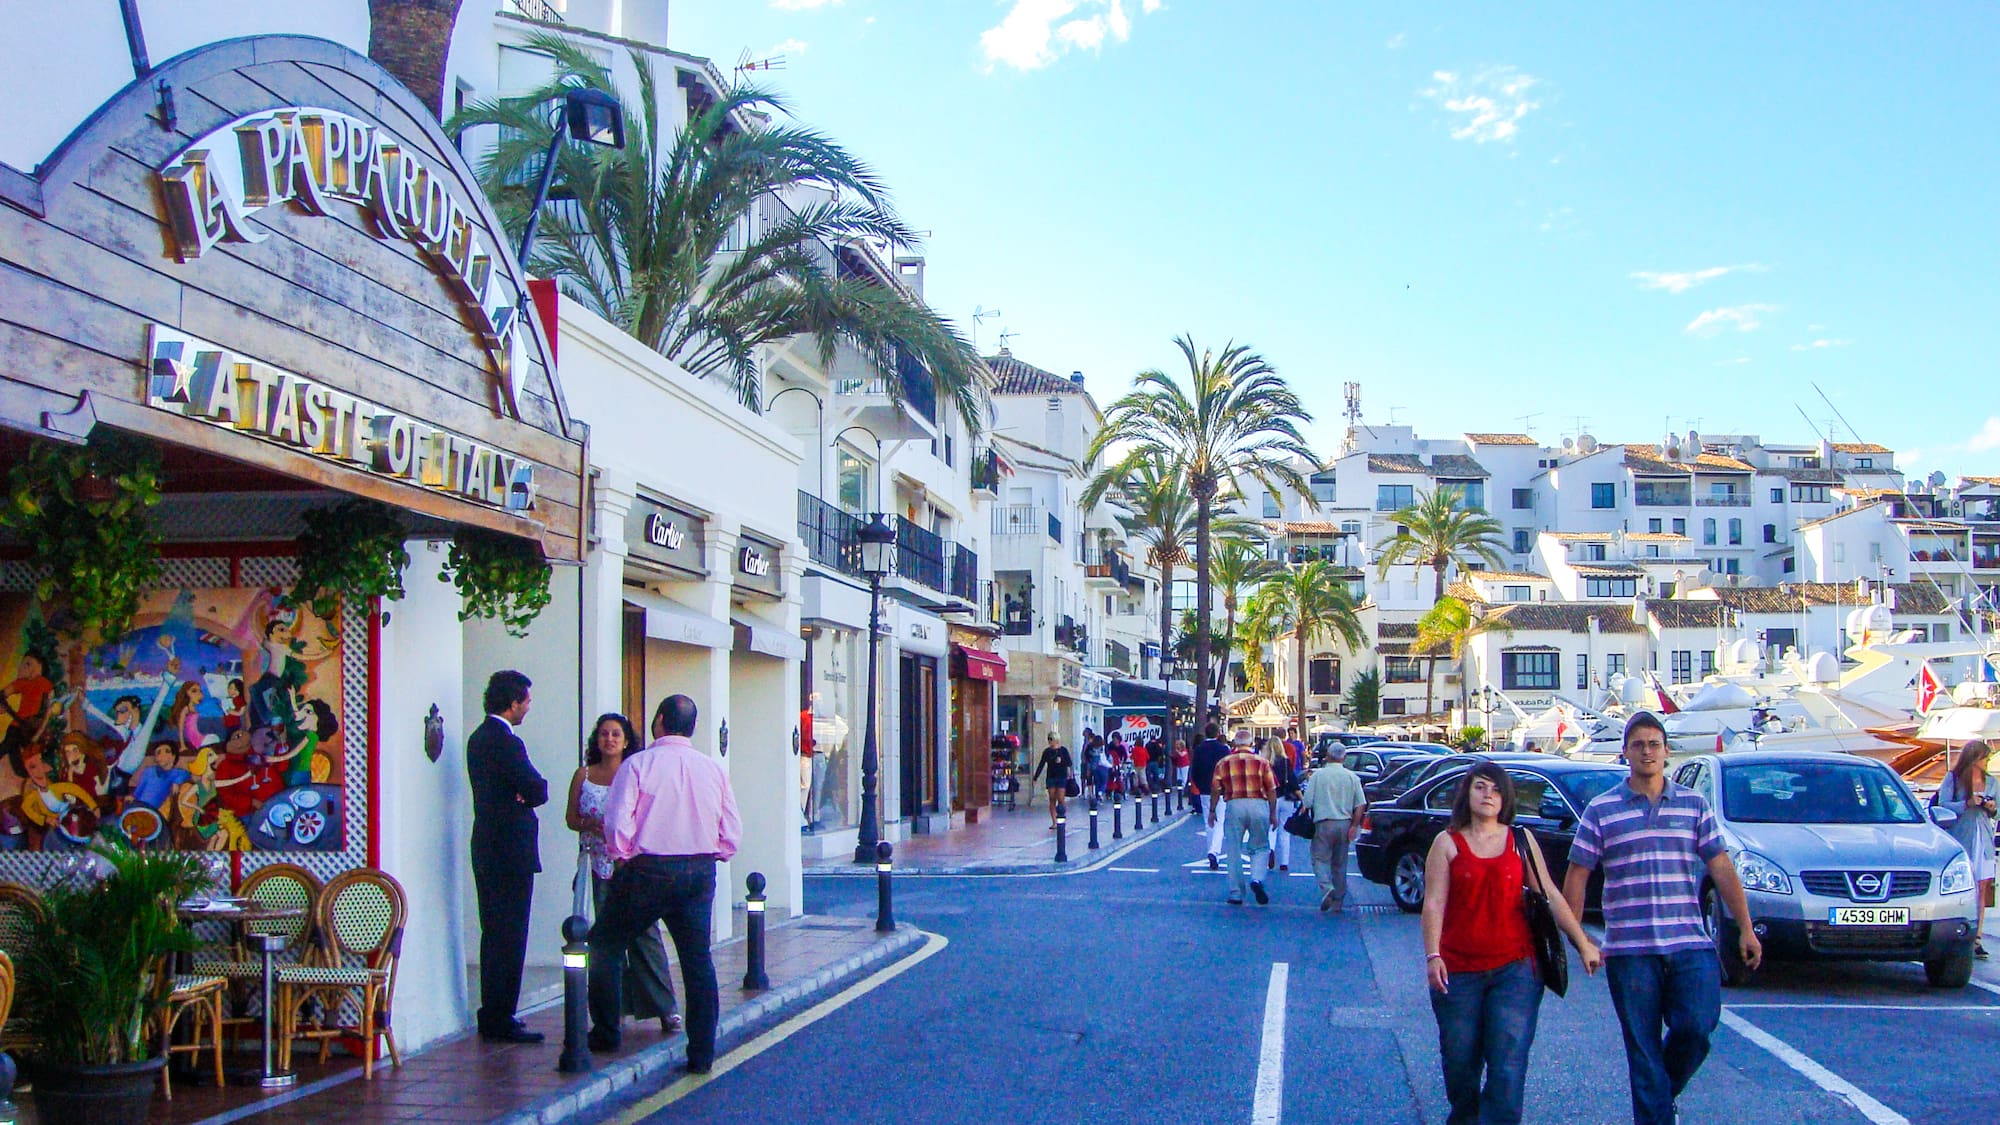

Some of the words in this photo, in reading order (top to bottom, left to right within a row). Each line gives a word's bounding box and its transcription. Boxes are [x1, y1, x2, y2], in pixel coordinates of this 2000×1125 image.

[175, 149, 269, 258] LA
[203, 351, 241, 423] A
[245, 365, 375, 464] TASTE
[384, 415, 433, 475] OF
[437, 432, 519, 508] ITALY
[652, 512, 685, 550] Cartier
[744, 546, 770, 577] Cartier
[1841, 910, 1874, 923] 4539
[1879, 910, 1904, 923] GHM
